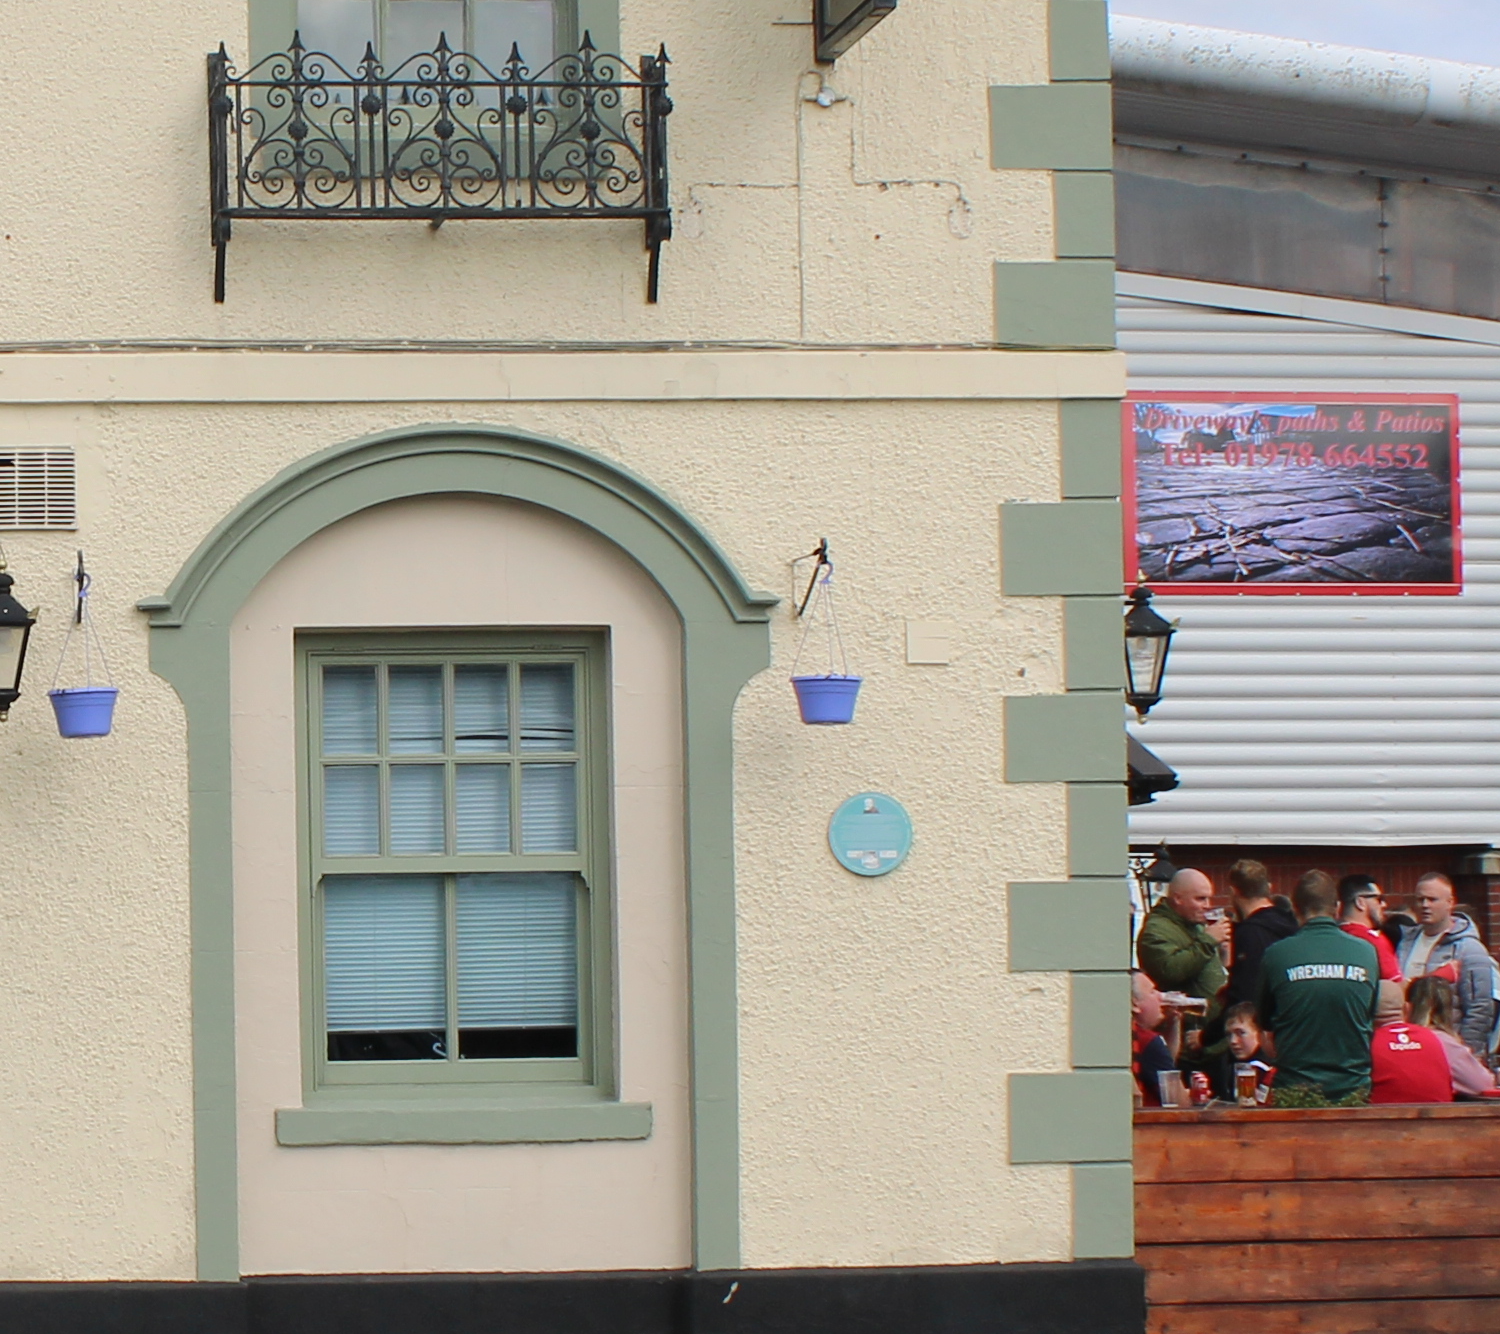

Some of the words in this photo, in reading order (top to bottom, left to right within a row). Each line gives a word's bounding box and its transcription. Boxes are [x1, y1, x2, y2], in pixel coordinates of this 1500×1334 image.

[1276, 409, 1340, 436] paths
[1347, 409, 1367, 433] &
[1373, 409, 1446, 434] Patios
[1160, 442, 1214, 467] Tel:
[1224, 442, 1315, 468] 01978
[1324, 443, 1431, 469] 664552
[1286, 964, 1345, 982] WREXHAM
[1346, 965, 1368, 982] AFC
